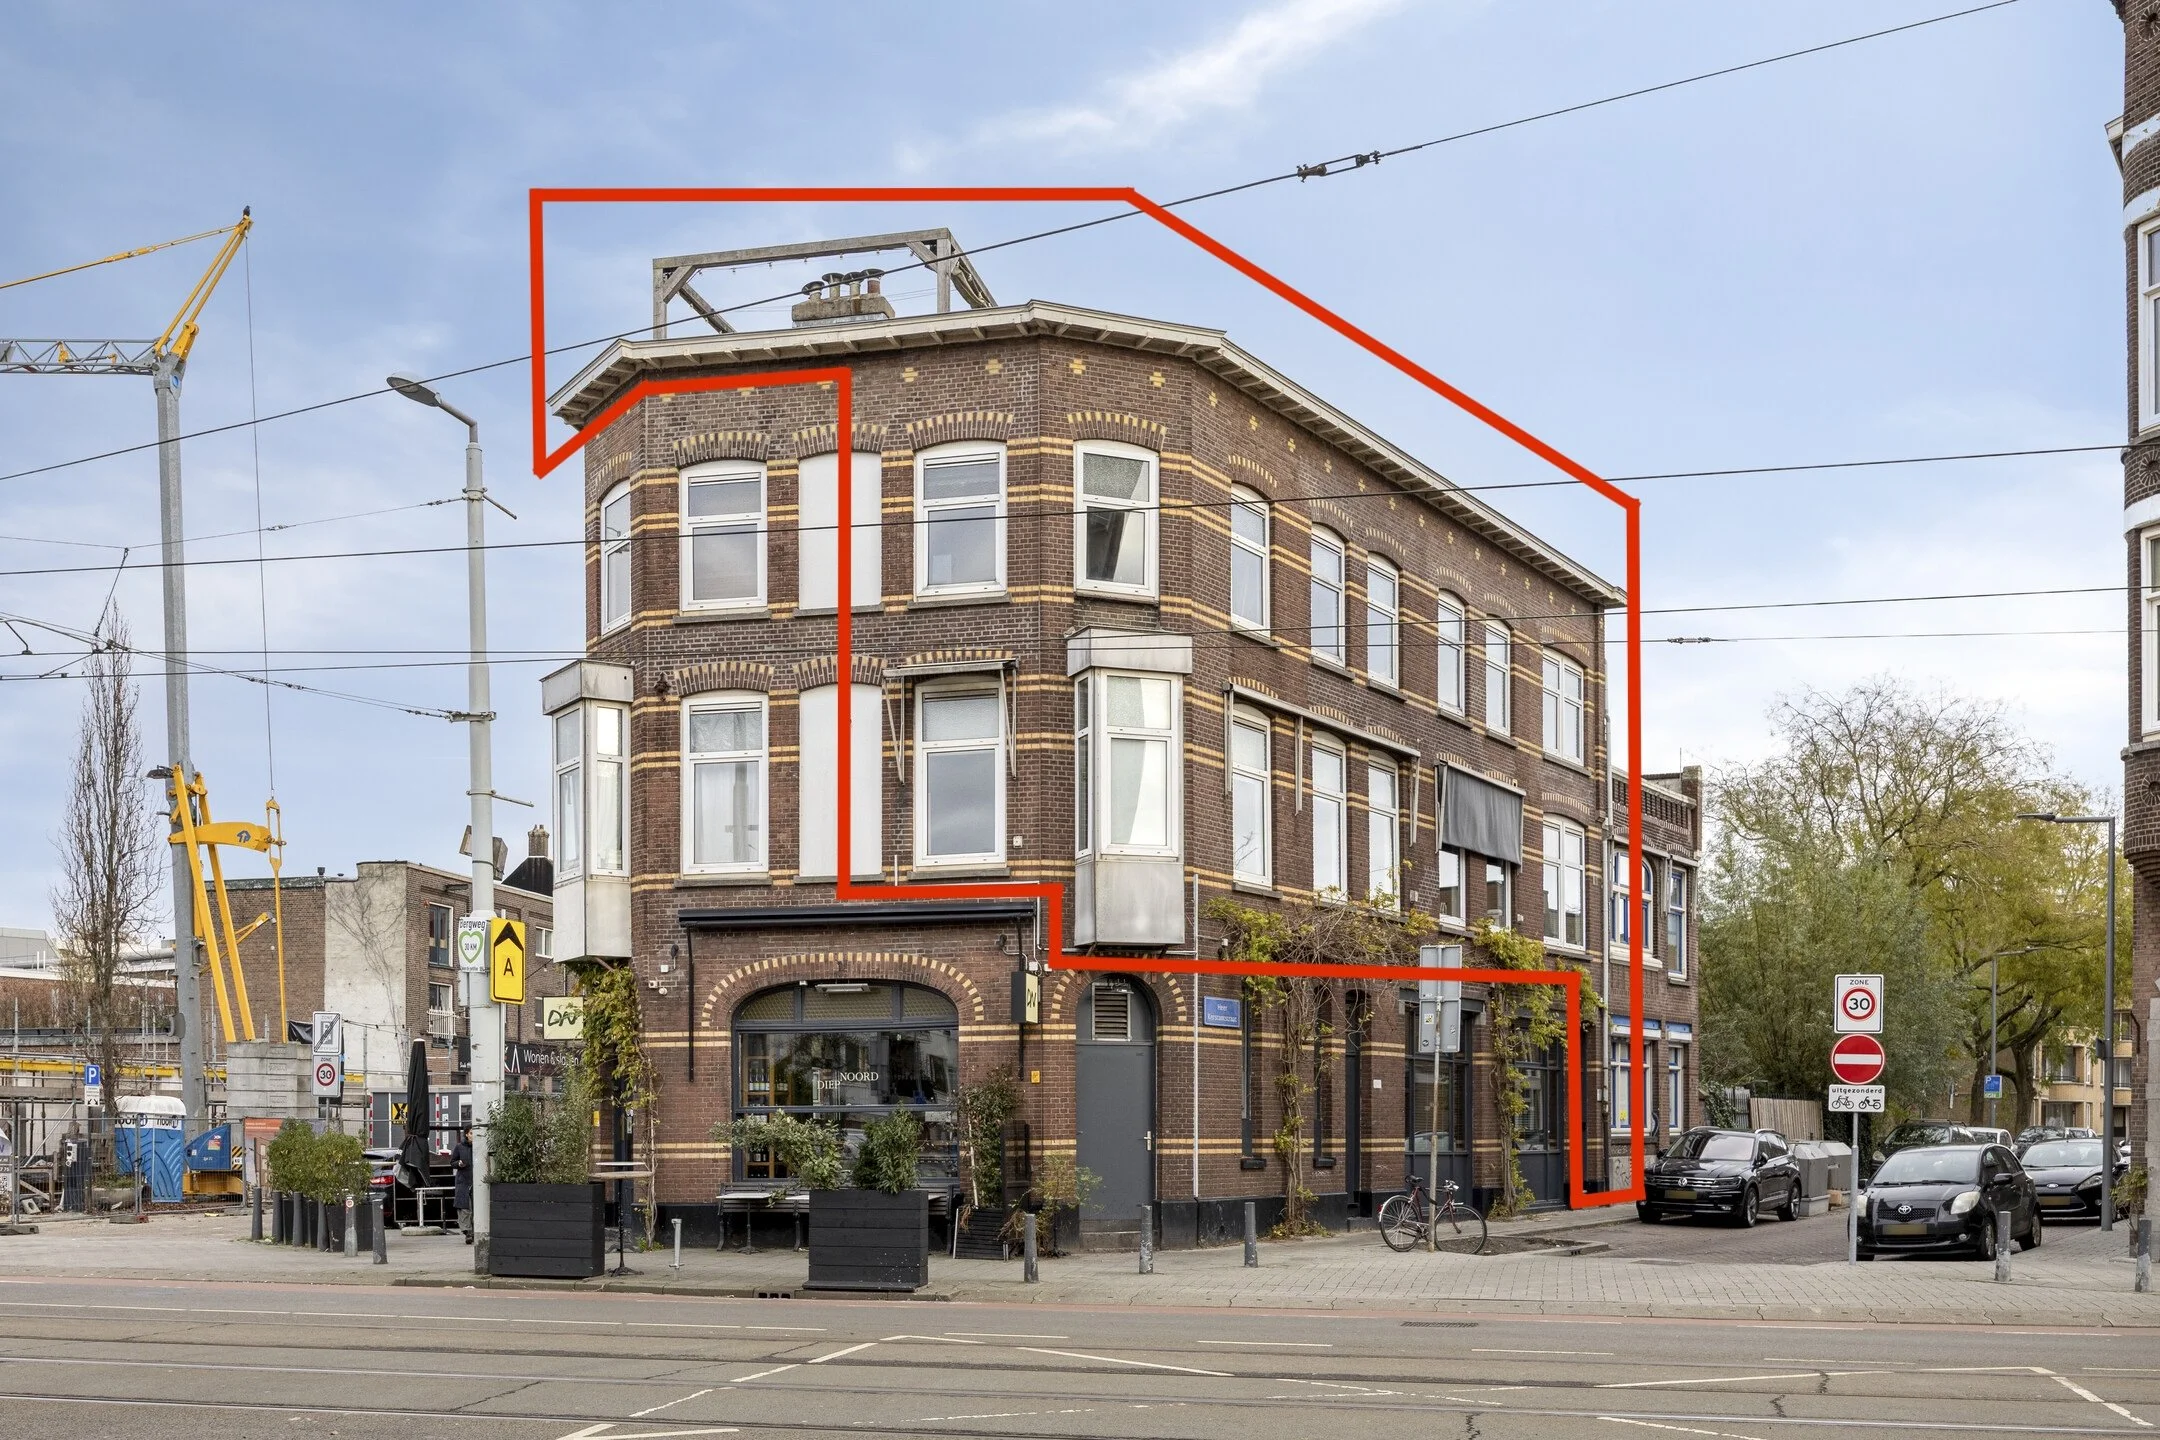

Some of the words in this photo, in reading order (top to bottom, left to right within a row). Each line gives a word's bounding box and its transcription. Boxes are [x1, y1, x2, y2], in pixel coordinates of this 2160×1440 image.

[503, 957, 514, 977] A
[1848, 998, 1870, 1011] 30
[523, 1049, 549, 1065] Wonen
[88, 1068, 97, 1083] P
[320, 1070, 332, 1079] 30
[840, 1071, 879, 1081] NOORD
[817, 1080, 841, 1089] DIEP
[1831, 1087, 1883, 1095] uitgezonderd
